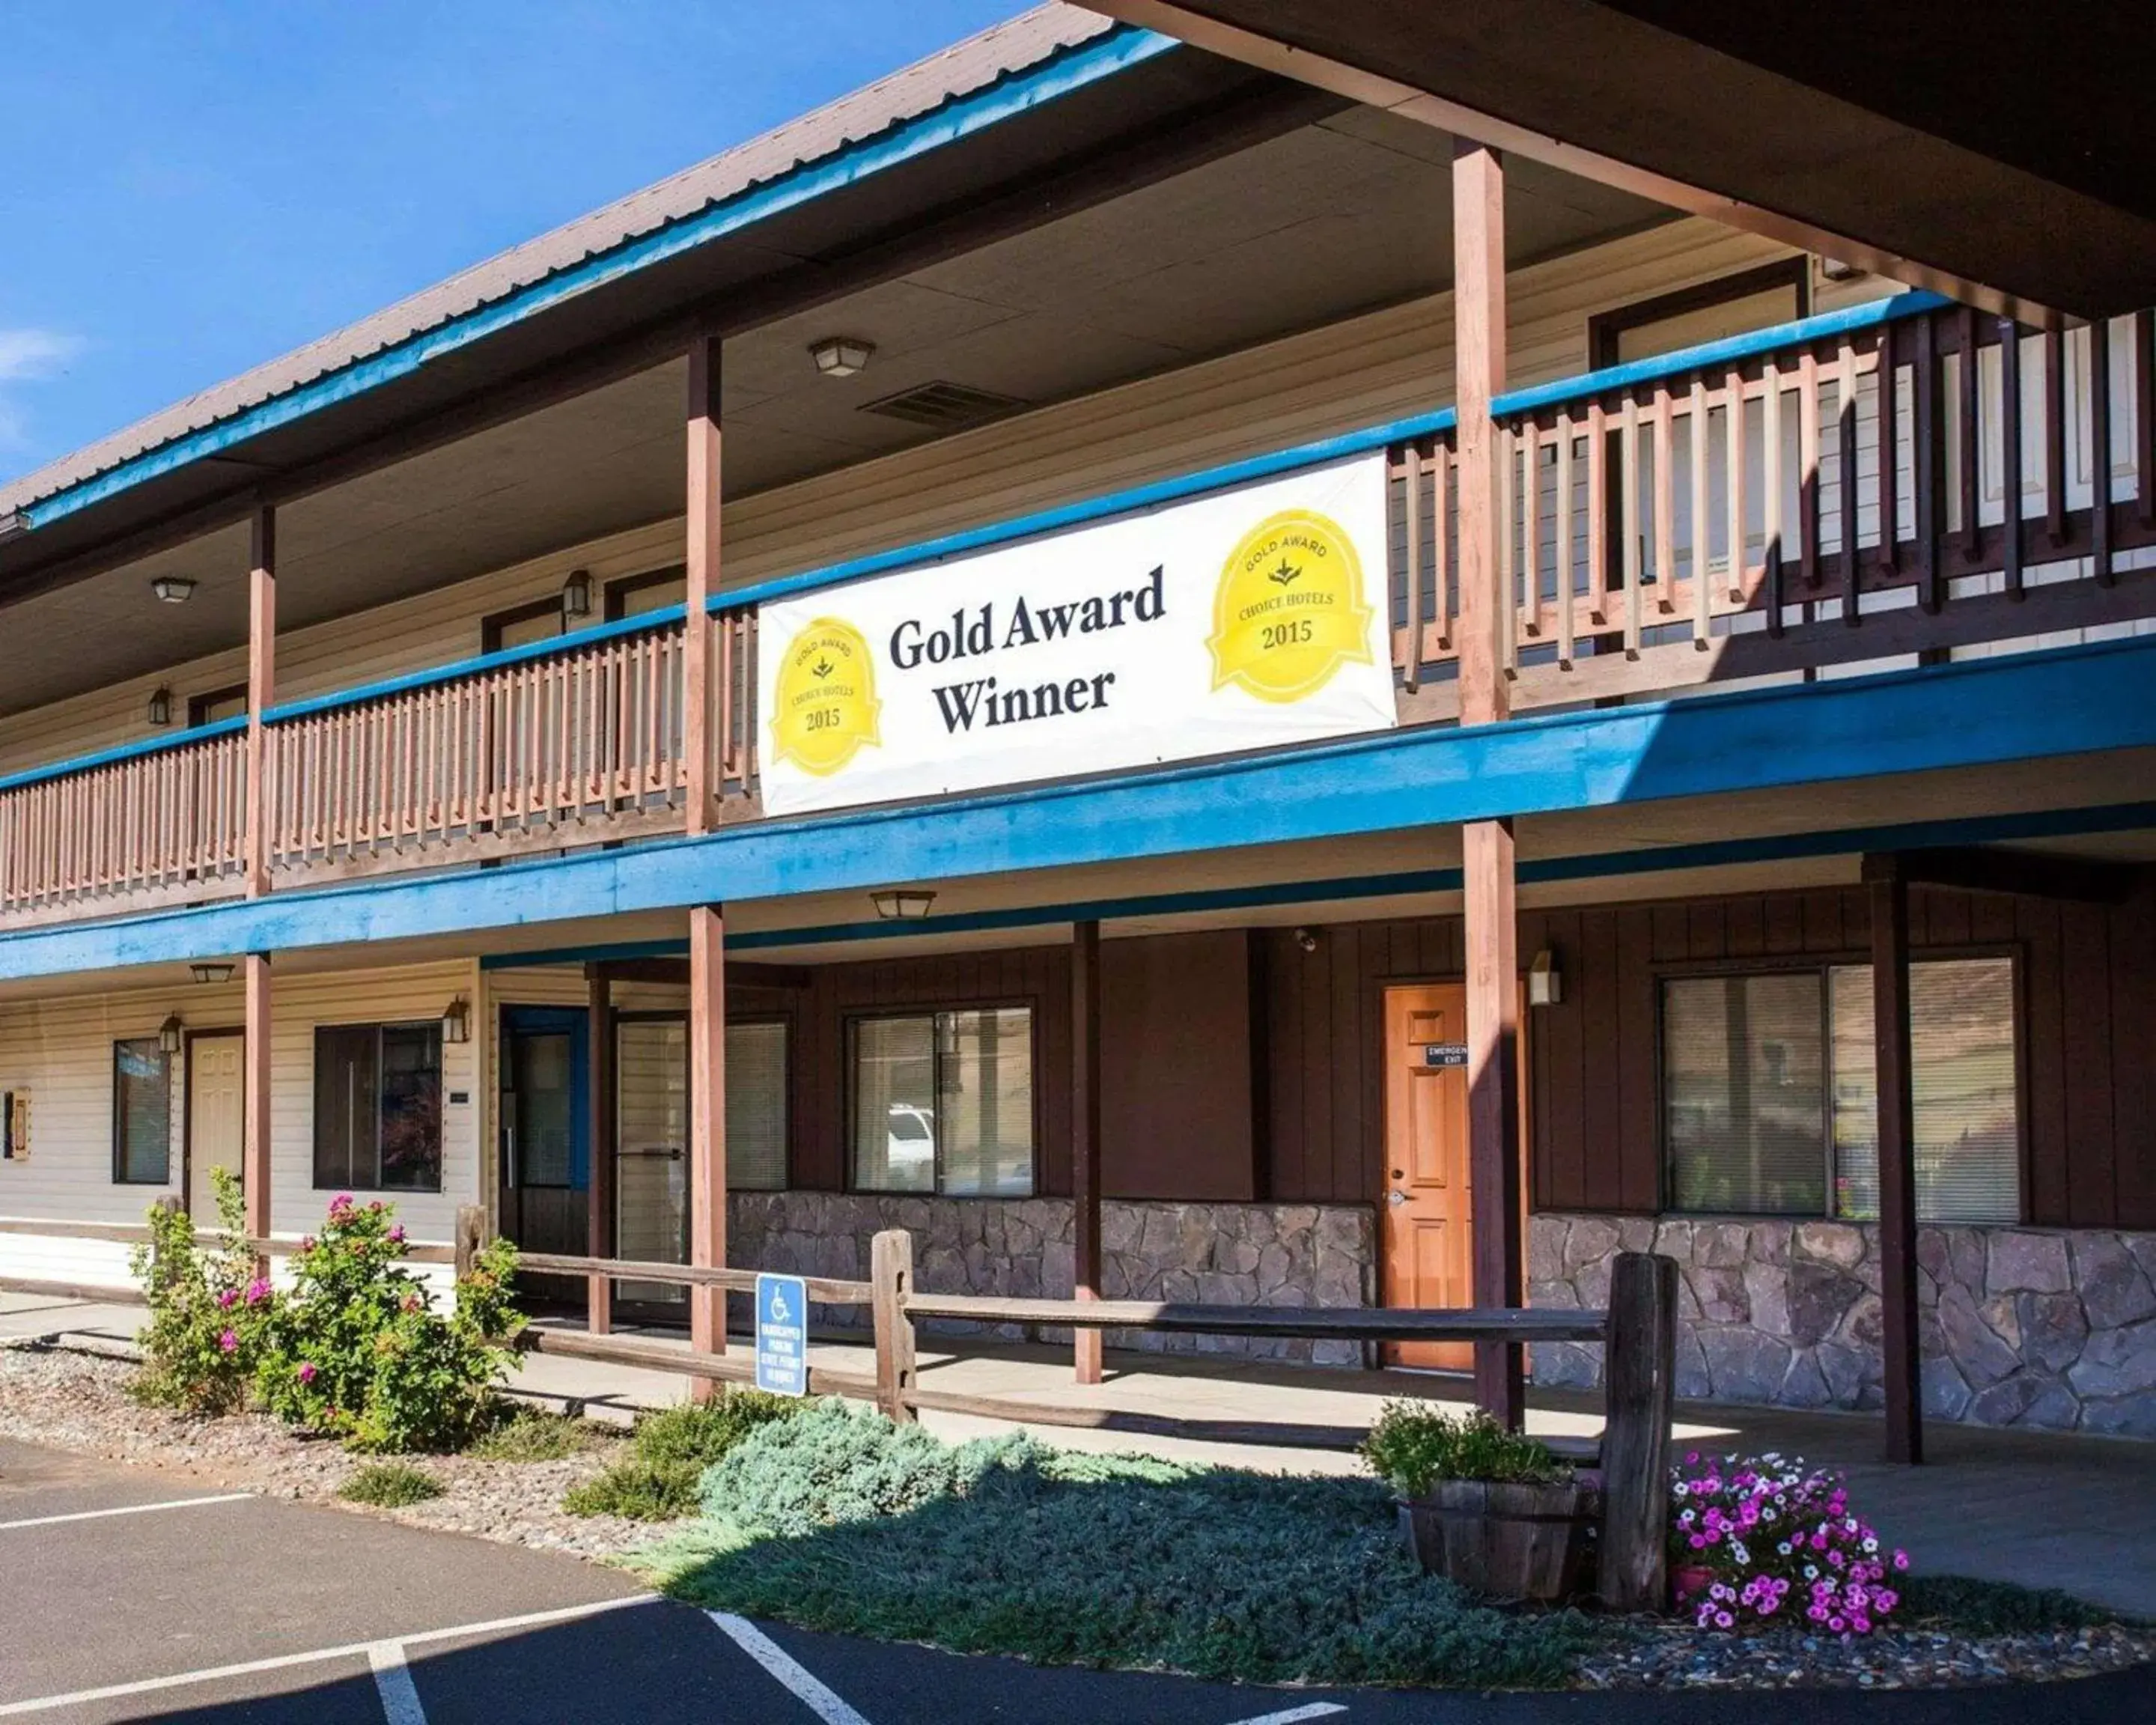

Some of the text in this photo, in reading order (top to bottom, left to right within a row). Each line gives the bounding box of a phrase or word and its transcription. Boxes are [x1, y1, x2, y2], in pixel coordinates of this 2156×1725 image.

[1246, 536, 1327, 572] GOLD AWARD
[889, 563, 1167, 670] Gold Award
[1239, 591, 1335, 621] CHOICE HOTELS
[1262, 619, 1313, 650] 2015
[795, 638, 852, 667] GOLD AWARD
[931, 672, 1116, 734] Winner
[806, 708, 841, 732] 2015
[1429, 1047, 1468, 1056] EMERGEN
